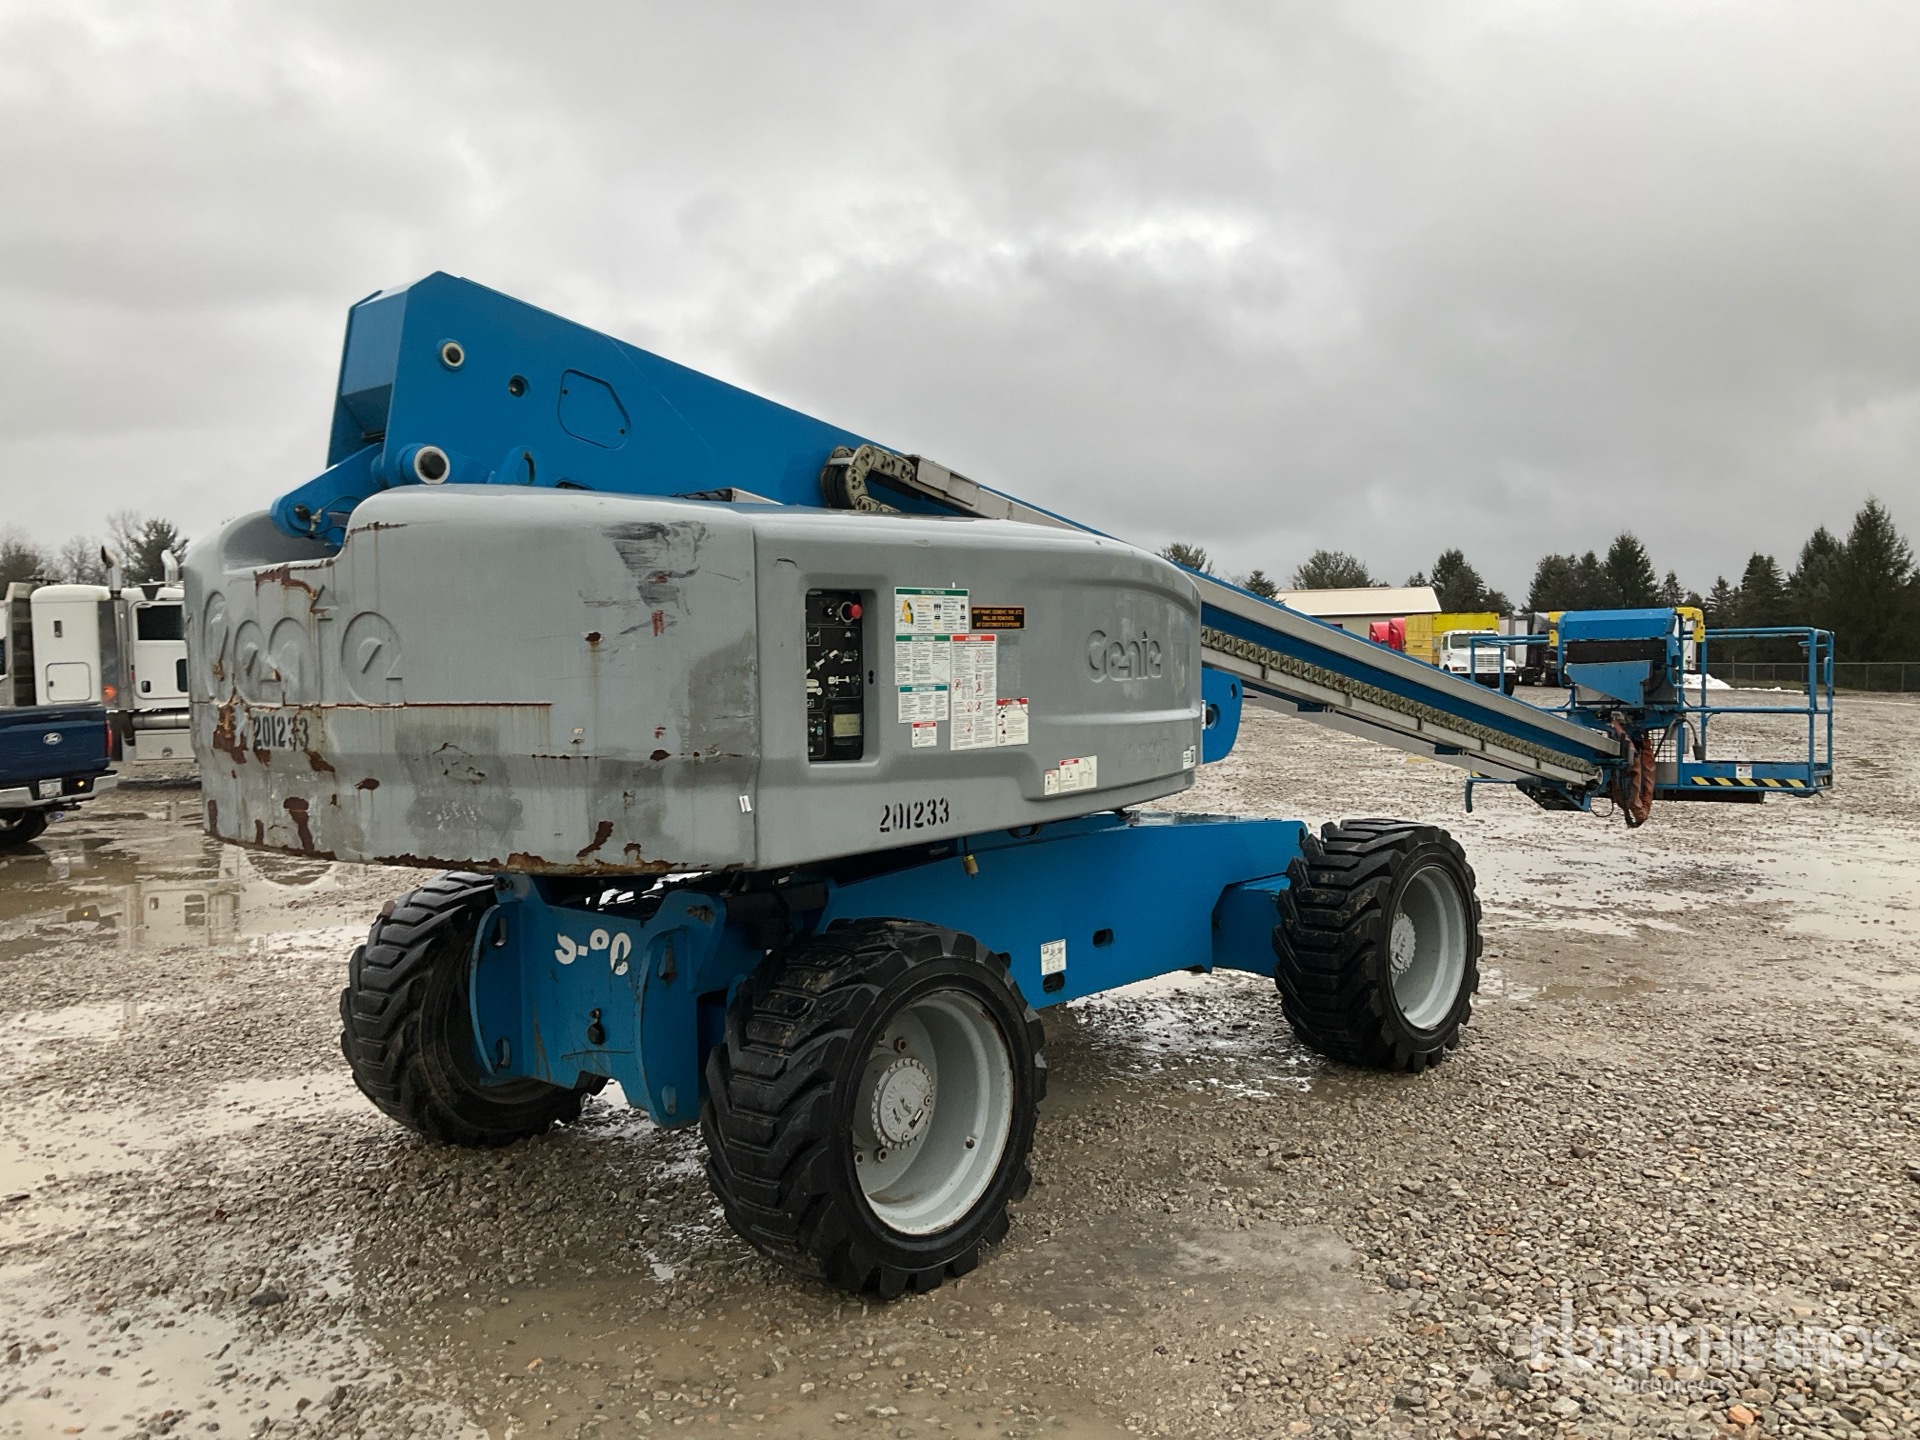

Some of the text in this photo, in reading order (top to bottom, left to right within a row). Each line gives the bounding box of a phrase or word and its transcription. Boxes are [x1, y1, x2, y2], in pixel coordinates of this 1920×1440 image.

[1086, 629, 1162, 683] Genie
[254, 715, 309, 749] 201233
[880, 797, 949, 833] 201233
